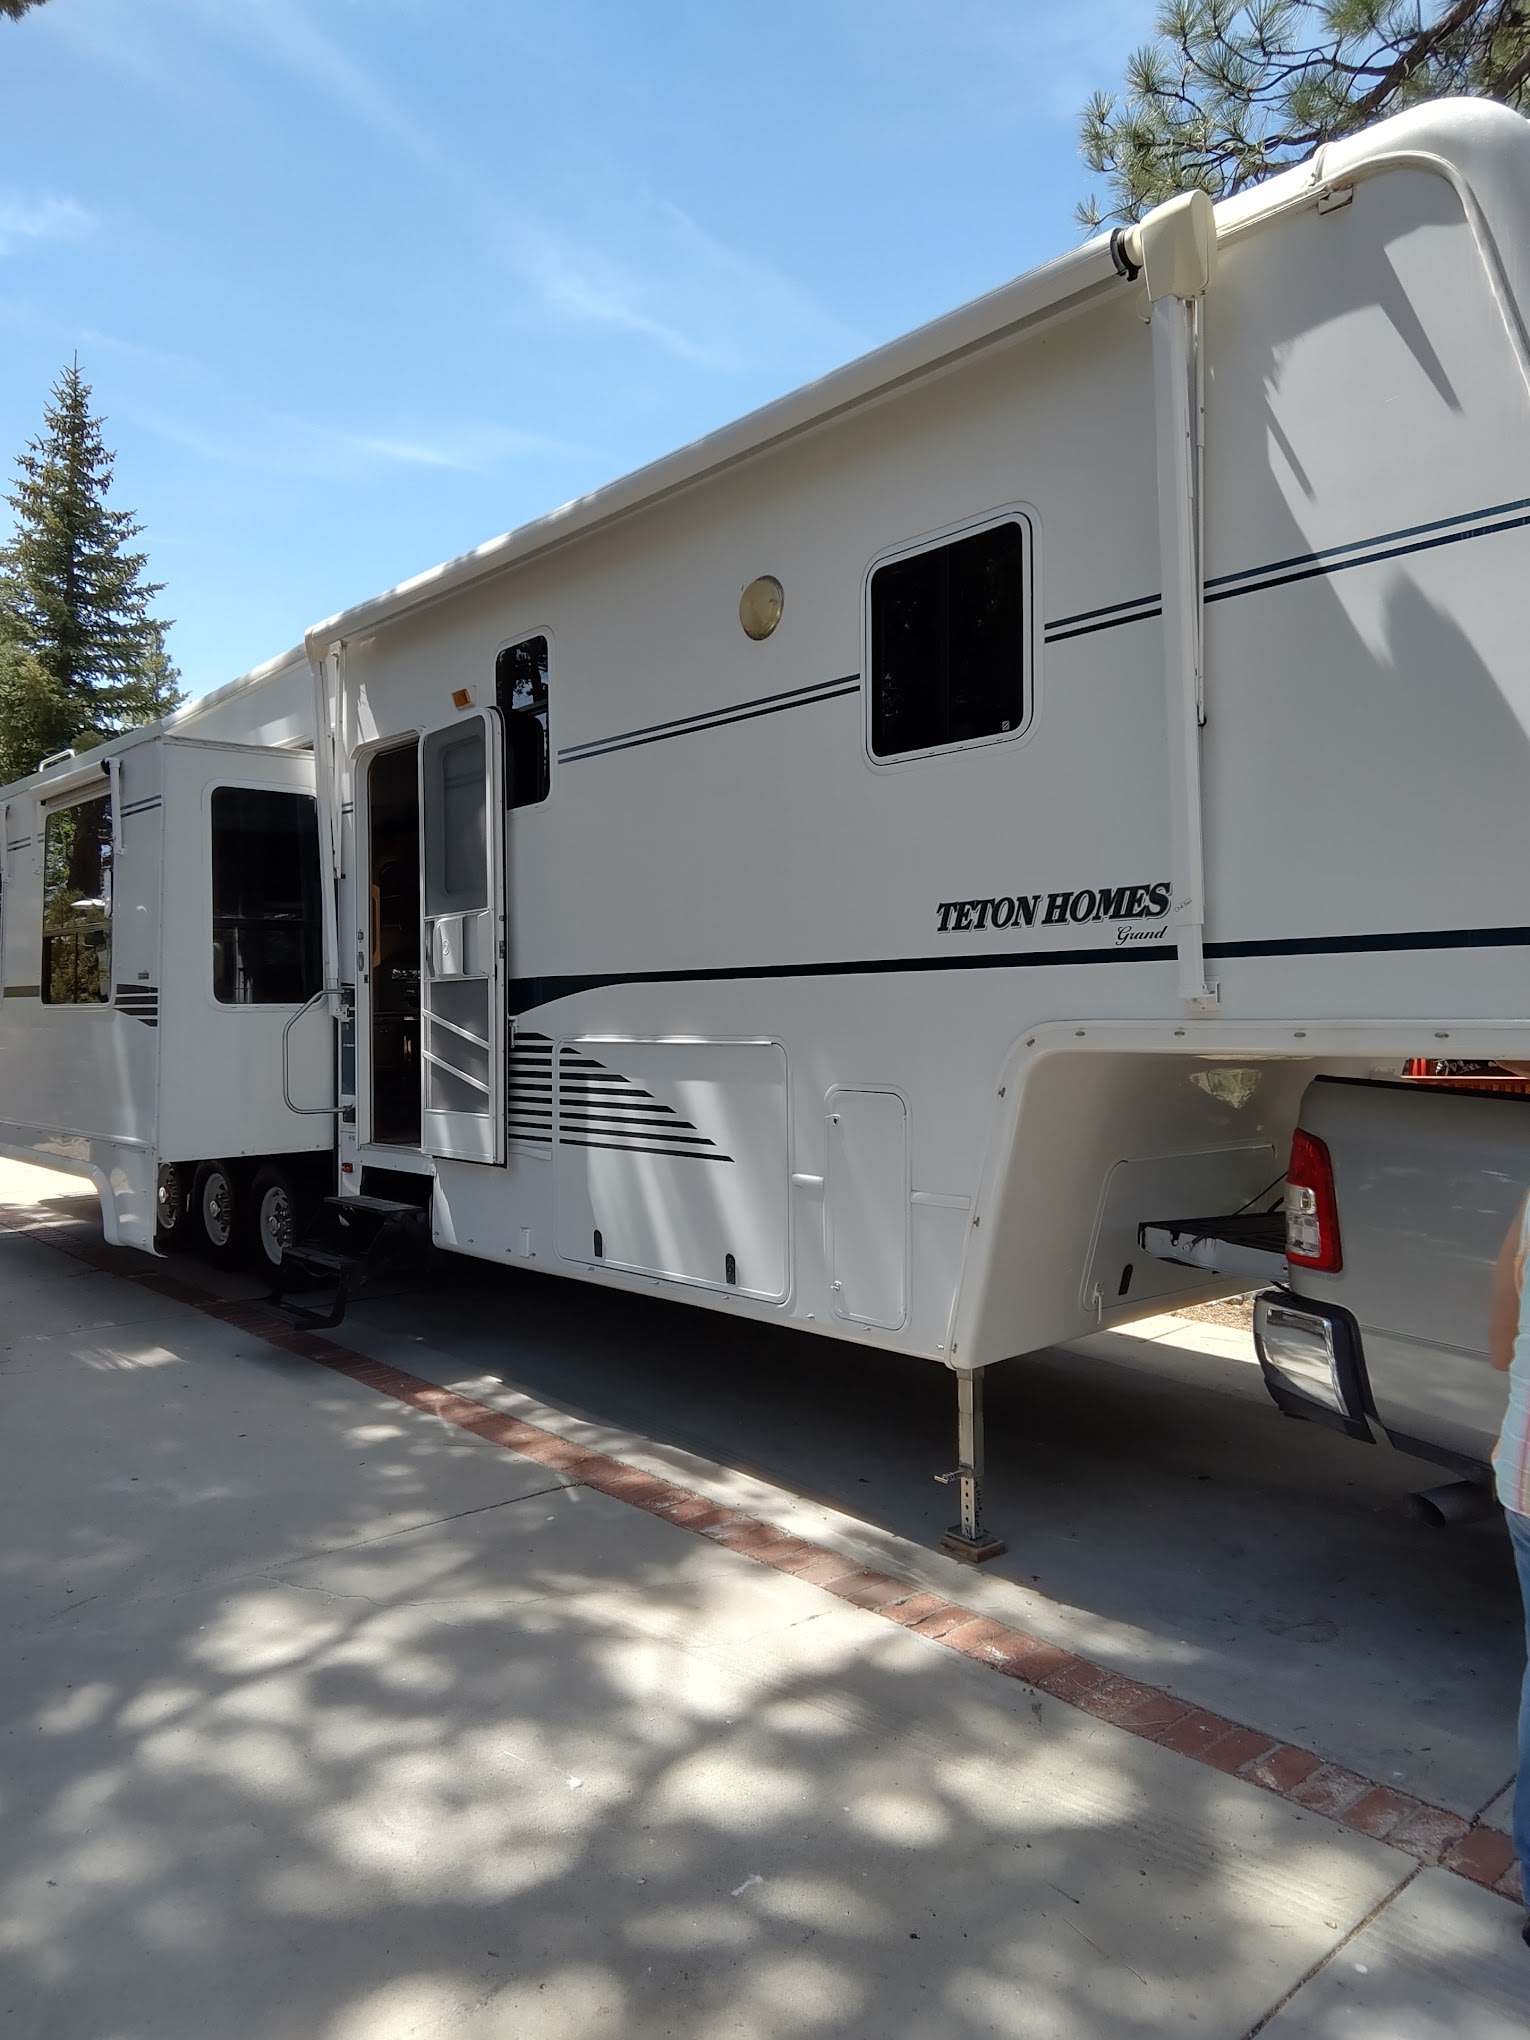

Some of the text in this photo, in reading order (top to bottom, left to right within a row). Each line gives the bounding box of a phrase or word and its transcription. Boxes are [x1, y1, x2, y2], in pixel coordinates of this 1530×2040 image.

[936, 881, 1172, 934] TETON HOMES
[1115, 925, 1168, 946] Grand
